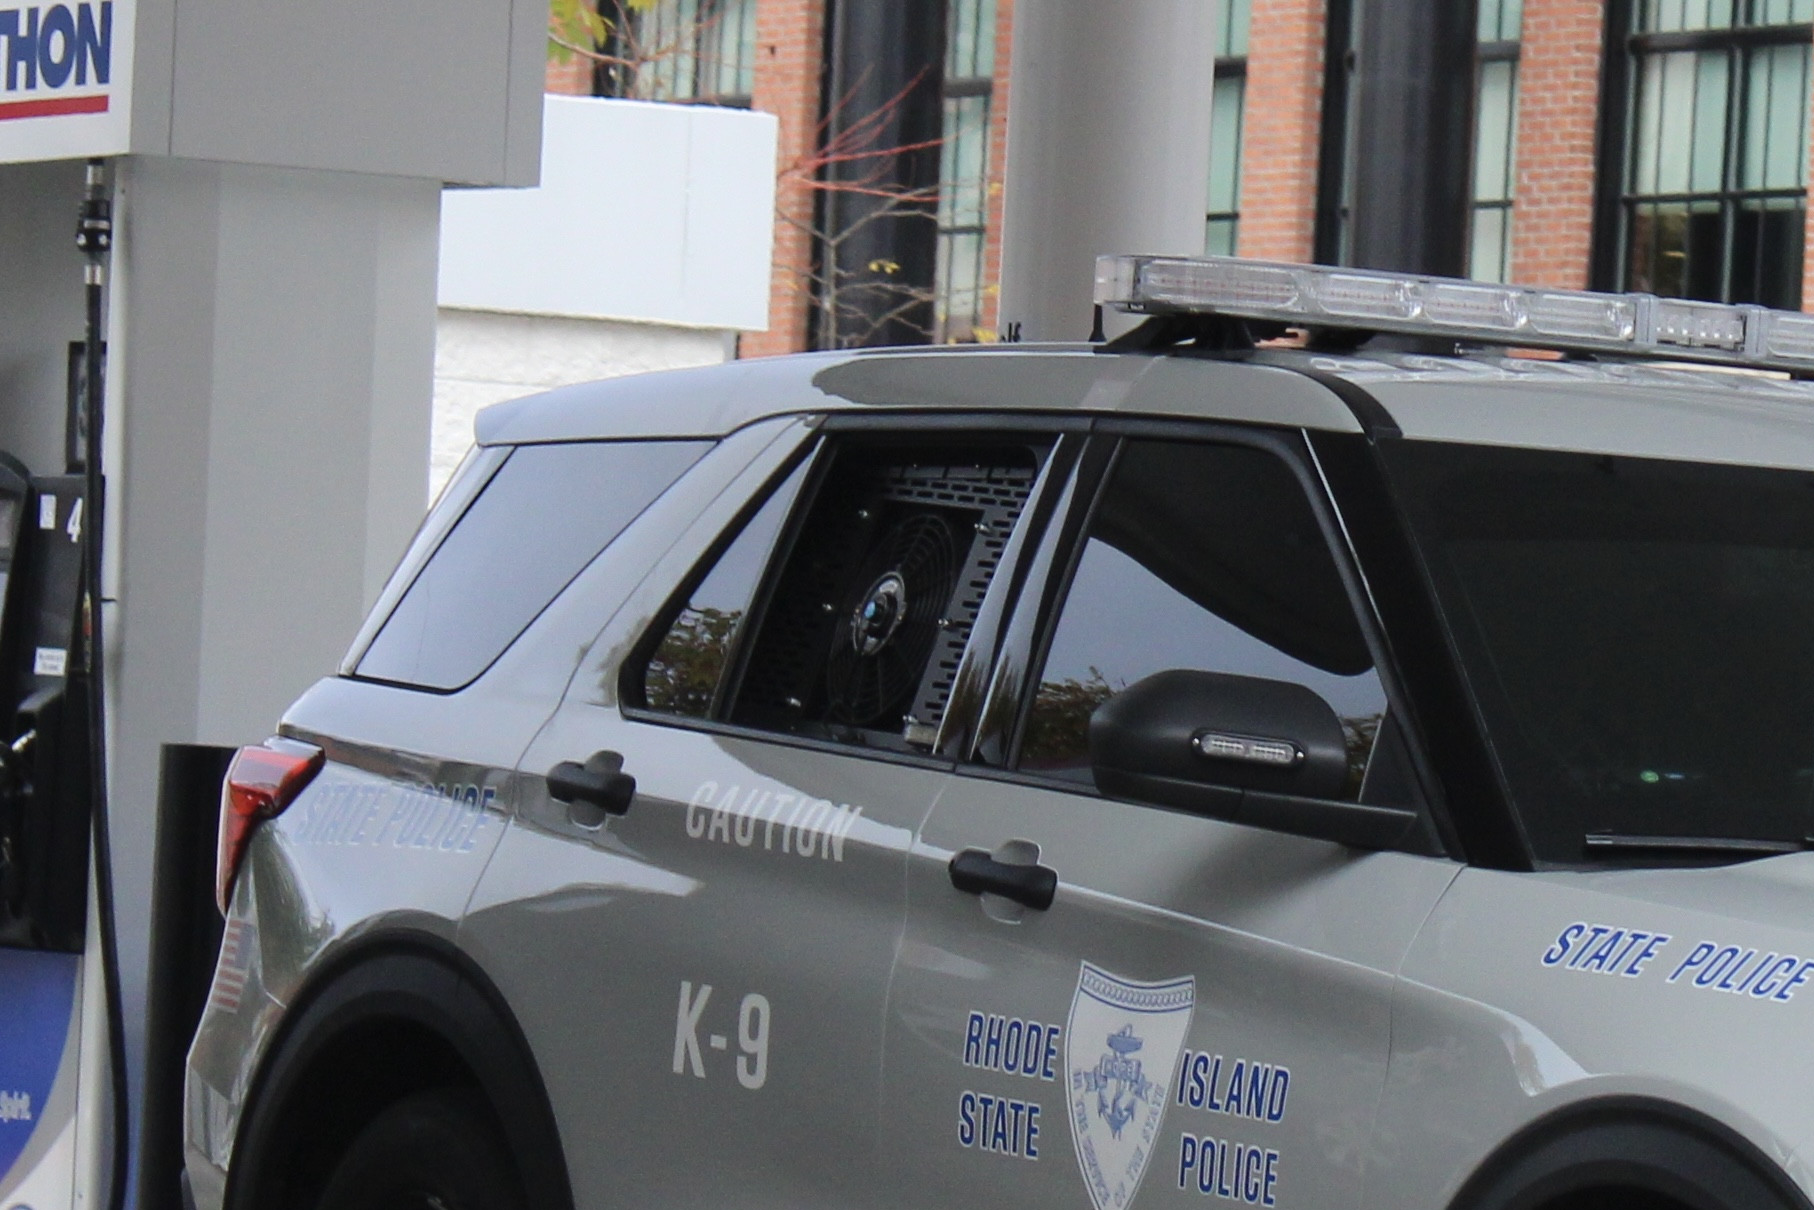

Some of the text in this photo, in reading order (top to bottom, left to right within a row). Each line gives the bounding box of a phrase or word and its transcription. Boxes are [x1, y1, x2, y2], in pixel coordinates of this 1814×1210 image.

[686, 780, 863, 863] CAUTION
[1541, 921, 1673, 979] STATE
[673, 981, 770, 1090] K-9
[963, 1010, 1291, 1124] RHODE ISLAND
[958, 1090, 1041, 1161] STATE
[1179, 1132, 1279, 1208] POLICE
